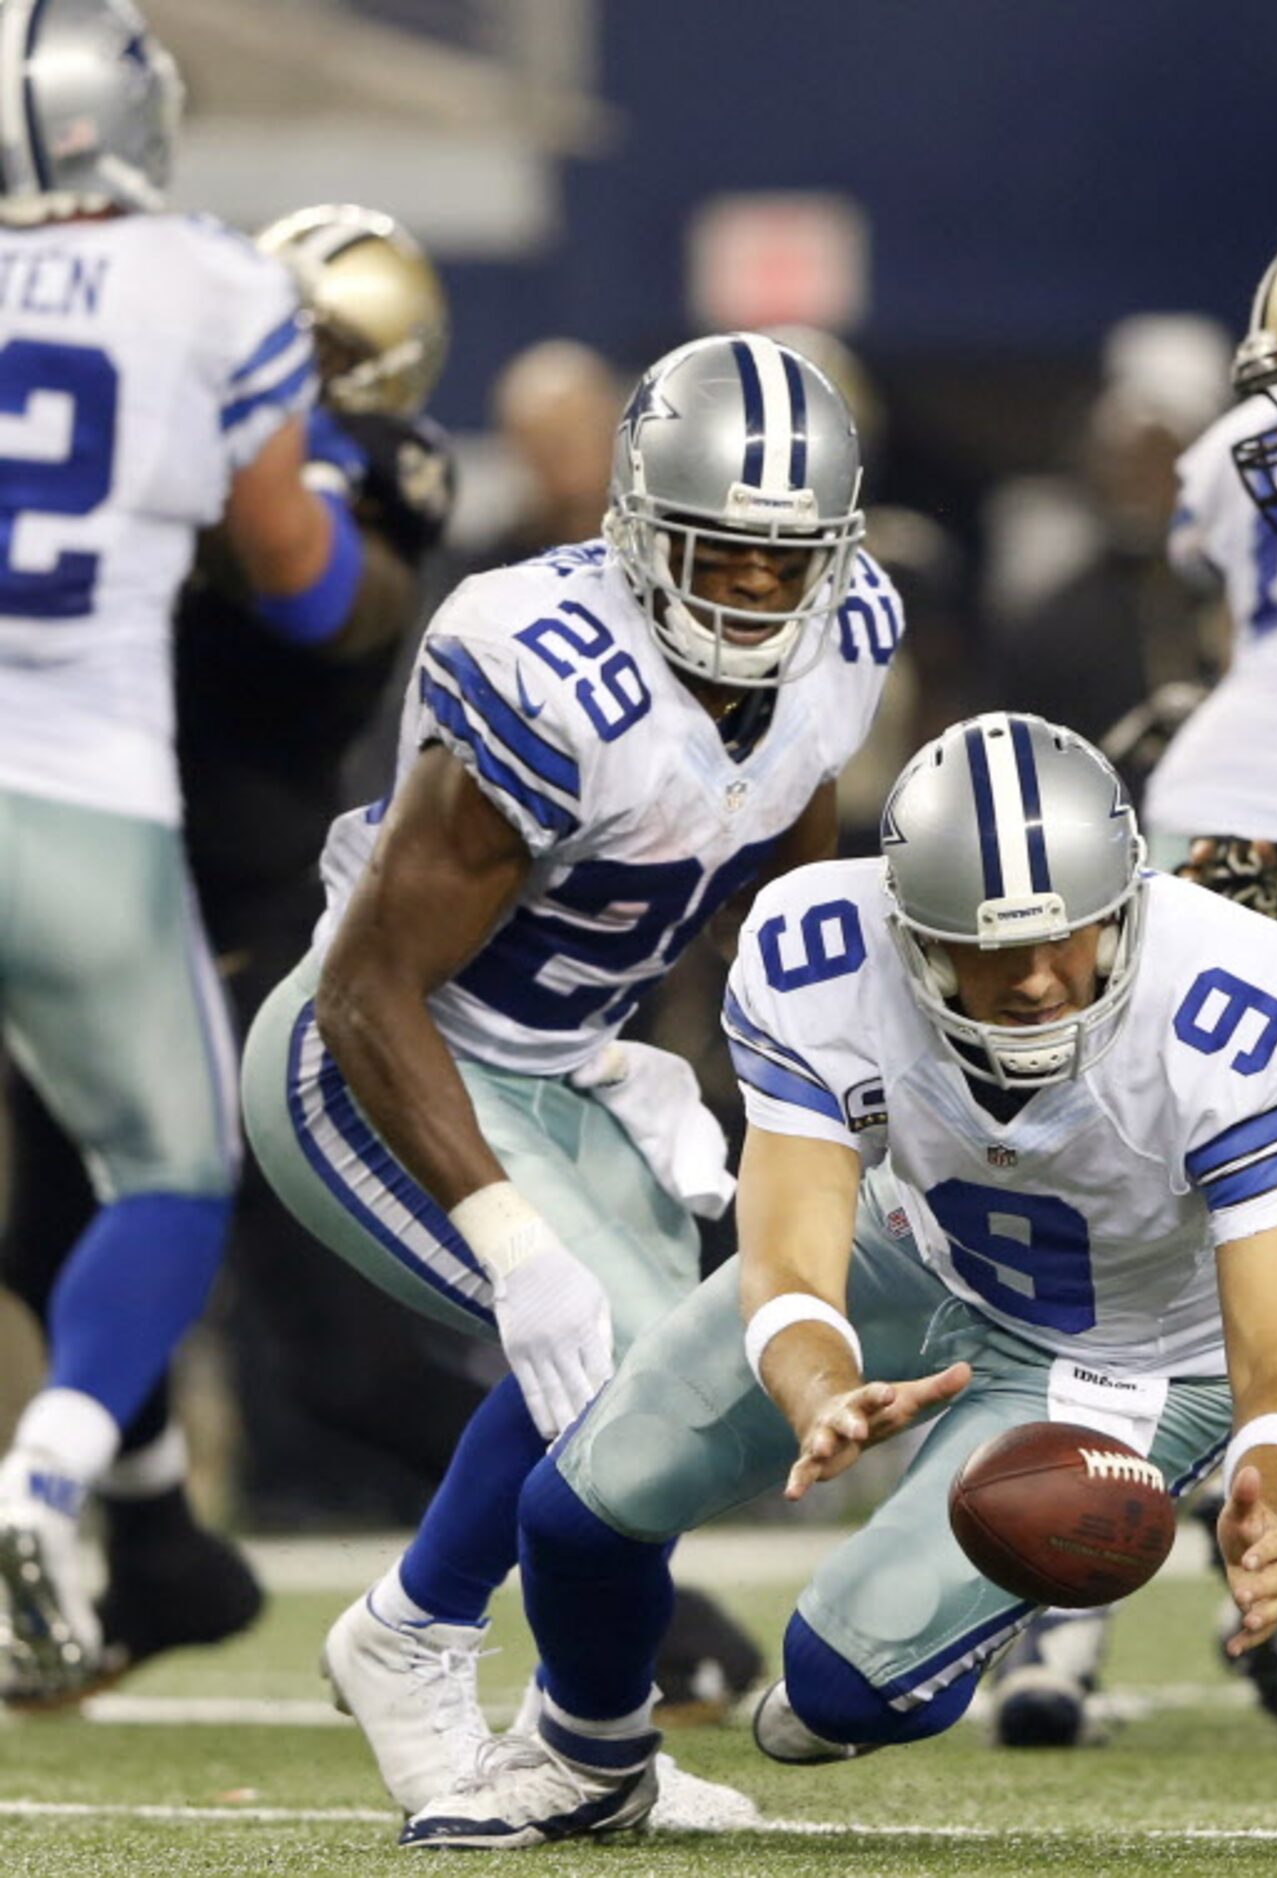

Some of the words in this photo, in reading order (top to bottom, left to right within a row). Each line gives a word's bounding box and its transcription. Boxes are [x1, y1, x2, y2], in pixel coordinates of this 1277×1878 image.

[513, 600, 652, 743] 29
[756, 898, 867, 993] 9
[924, 1176, 1097, 1336] 9
[1073, 1366, 1138, 1391] Wilson
